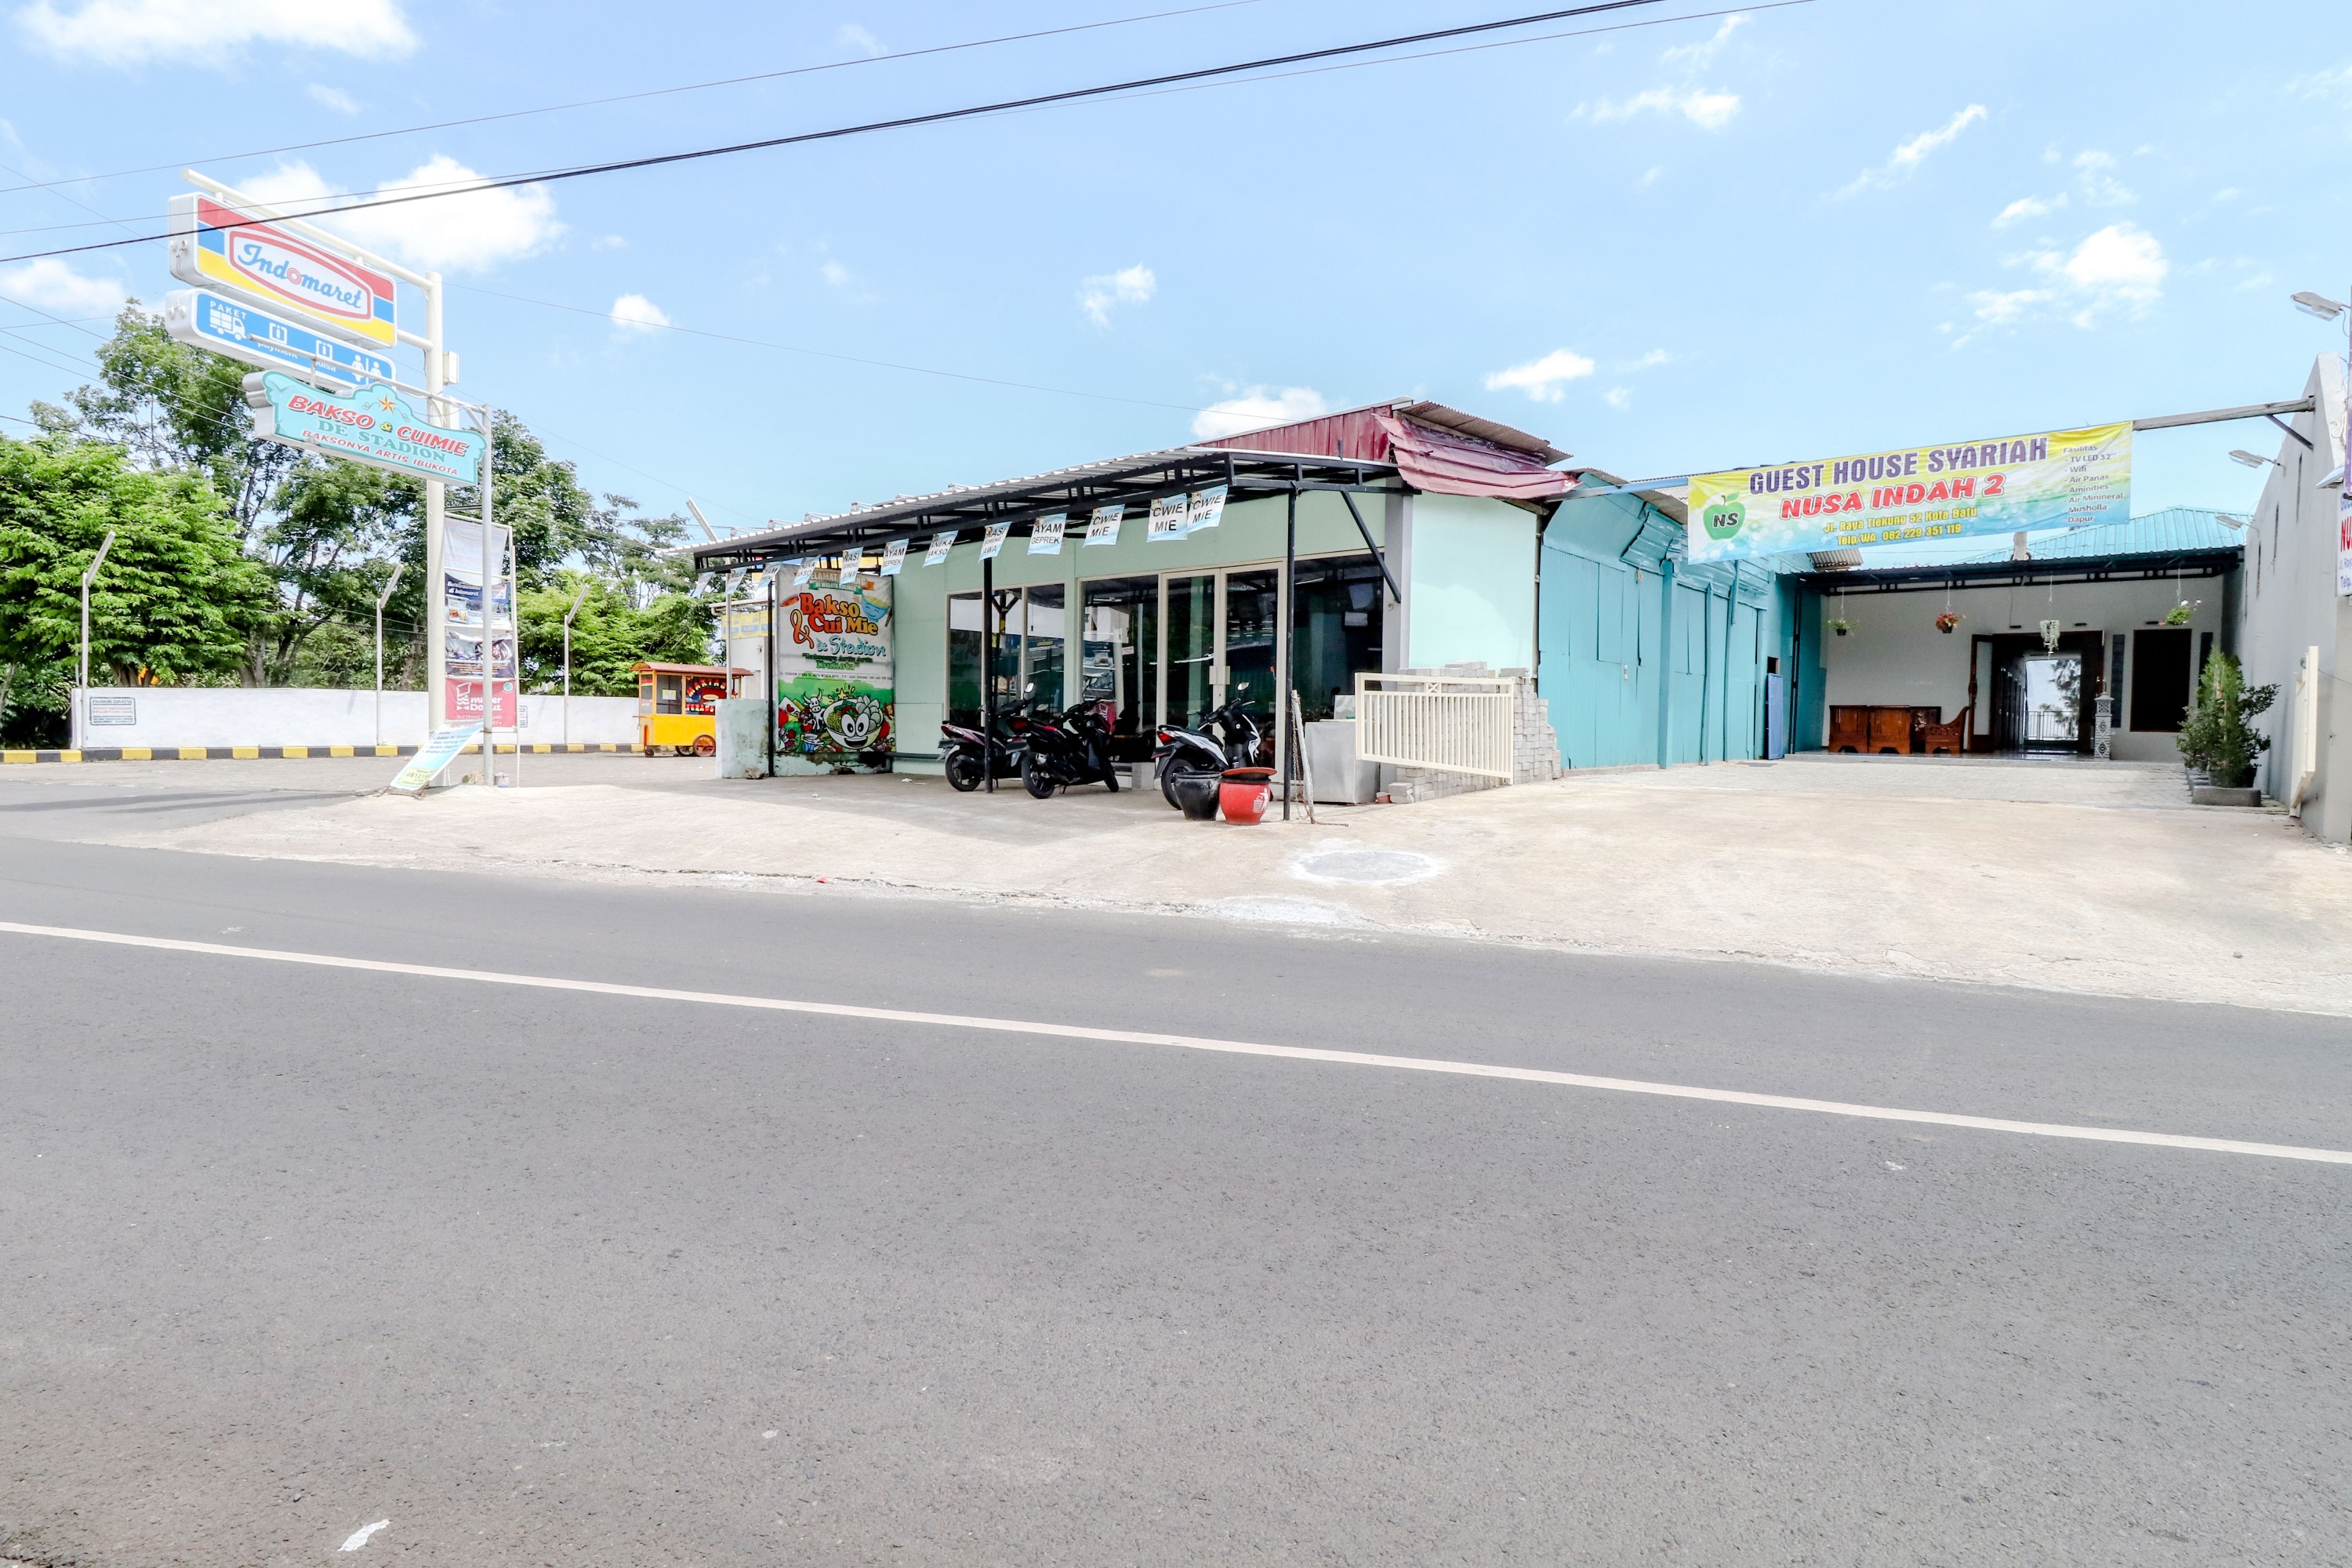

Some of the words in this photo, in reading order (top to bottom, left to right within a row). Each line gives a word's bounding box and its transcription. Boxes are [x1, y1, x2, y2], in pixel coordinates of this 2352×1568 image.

[238, 243, 361, 310] Indomaret
[210, 300, 247, 320] PAKET
[288, 394, 376, 430] BAKSO
[379, 421, 394, 433] &
[396, 426, 471, 456] CUIMIE
[318, 419, 349, 437] DE
[358, 430, 447, 463] STADION
[2063, 445, 2098, 454] Fasilitas
[302, 429, 371, 453] BAKSONYA
[375, 448, 409, 463] ARTIS
[413, 458, 459, 476] IBUKOTA
[1750, 463, 1824, 495] GUEST
[1833, 452, 1918, 485] HOUSE
[1928, 437, 2048, 473] SYARIAH
[2069, 484, 2109, 493] Aminities
[1192, 493, 1223, 510] CWIE
[1780, 490, 1864, 521] NUSA
[1871, 477, 1977, 509] INDAH
[1982, 474, 2007, 498] 2
[1152, 503, 1184, 517] CWIE
[1193, 509, 1213, 524] MIE
[2068, 503, 2107, 513] Musholla
[1092, 513, 1119, 526] CWIE
[1154, 519, 1178, 533] MIE
[1713, 512, 1739, 528] NS
[1824, 522, 1836, 533] Jl.
[1839, 521, 1864, 532] Raya
[1867, 514, 1906, 528] Tlekung
[1909, 514, 1922, 523] 52
[1926, 510, 1948, 521] Kota
[1952, 506, 1977, 518] Batu
[1034, 523, 1062, 534] AYAM
[1090, 526, 1110, 538] MIE
[1837, 532, 1876, 546] Telp/WA
[1904, 527, 1922, 539] 229
[1925, 525, 1943, 536] 351
[1946, 524, 1962, 534] 119
[1031, 535, 1061, 545] GEPREK
[884, 547, 906, 558] AYAM
[798, 592, 861, 619] Bakso
[789, 608, 815, 649] &
[808, 612, 843, 635] Cui
[845, 614, 880, 637] Mie
[816, 637, 828, 652] de
[828, 633, 887, 657] Stadion
